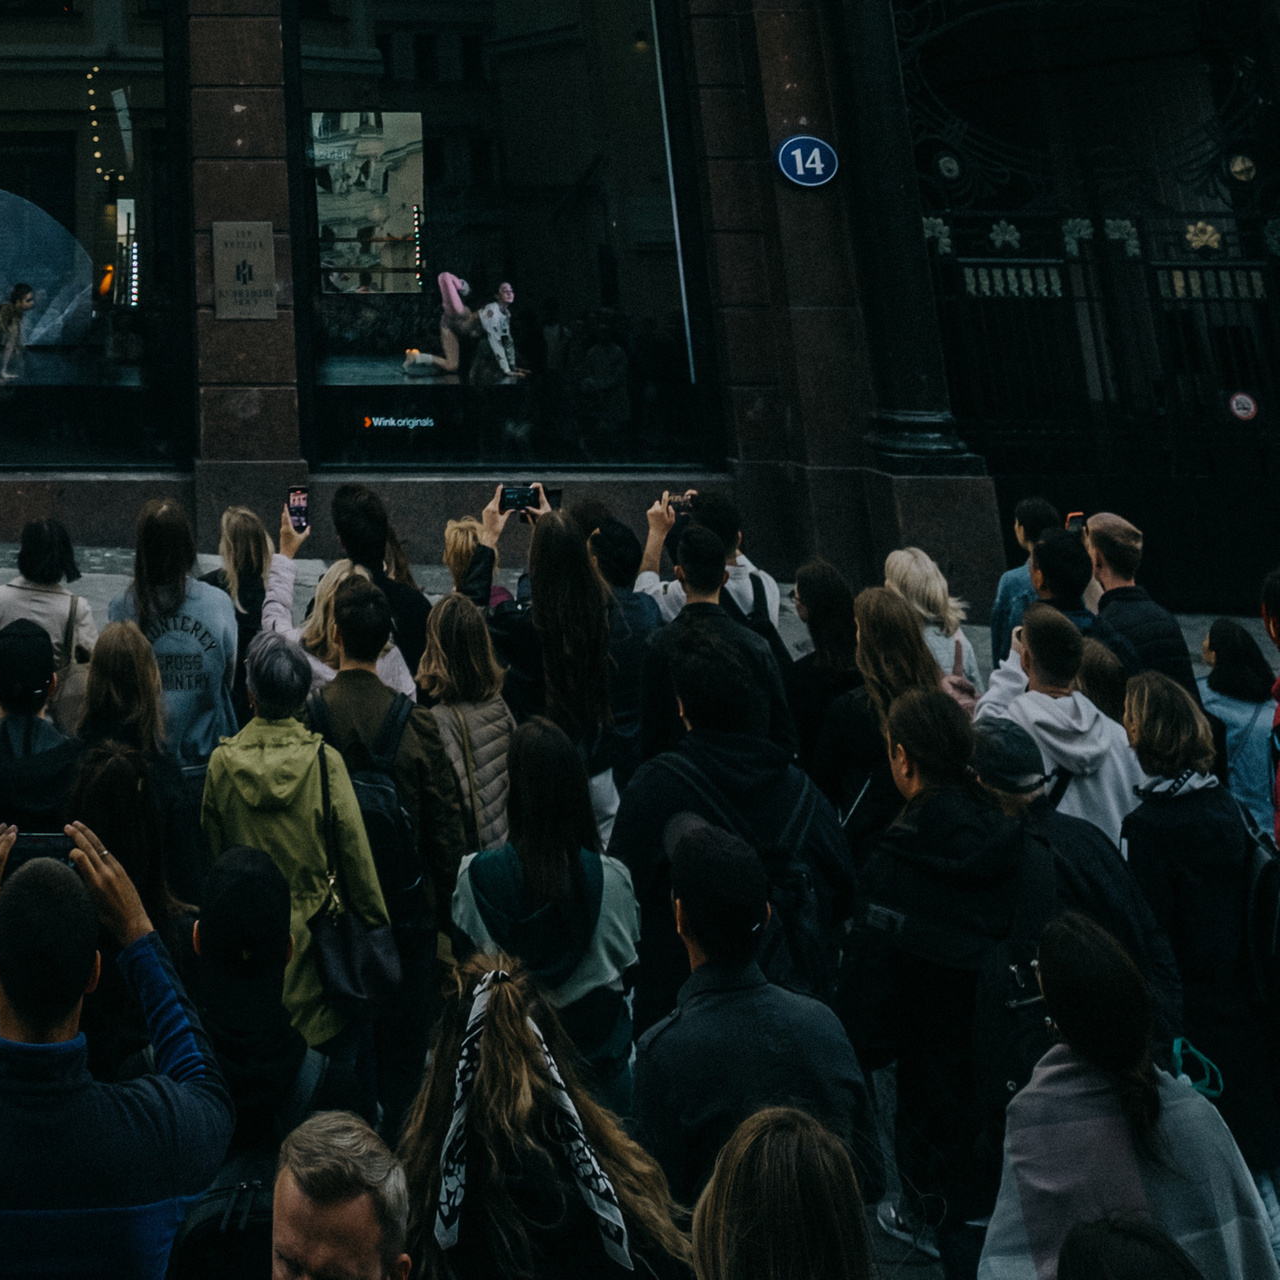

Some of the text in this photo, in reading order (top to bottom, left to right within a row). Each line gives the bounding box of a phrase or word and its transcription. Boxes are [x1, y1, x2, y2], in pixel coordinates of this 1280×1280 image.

[791, 147, 825, 175] 14
[372, 417, 435, 430] Wink originals
[147, 615, 217, 652] ONTEREY
